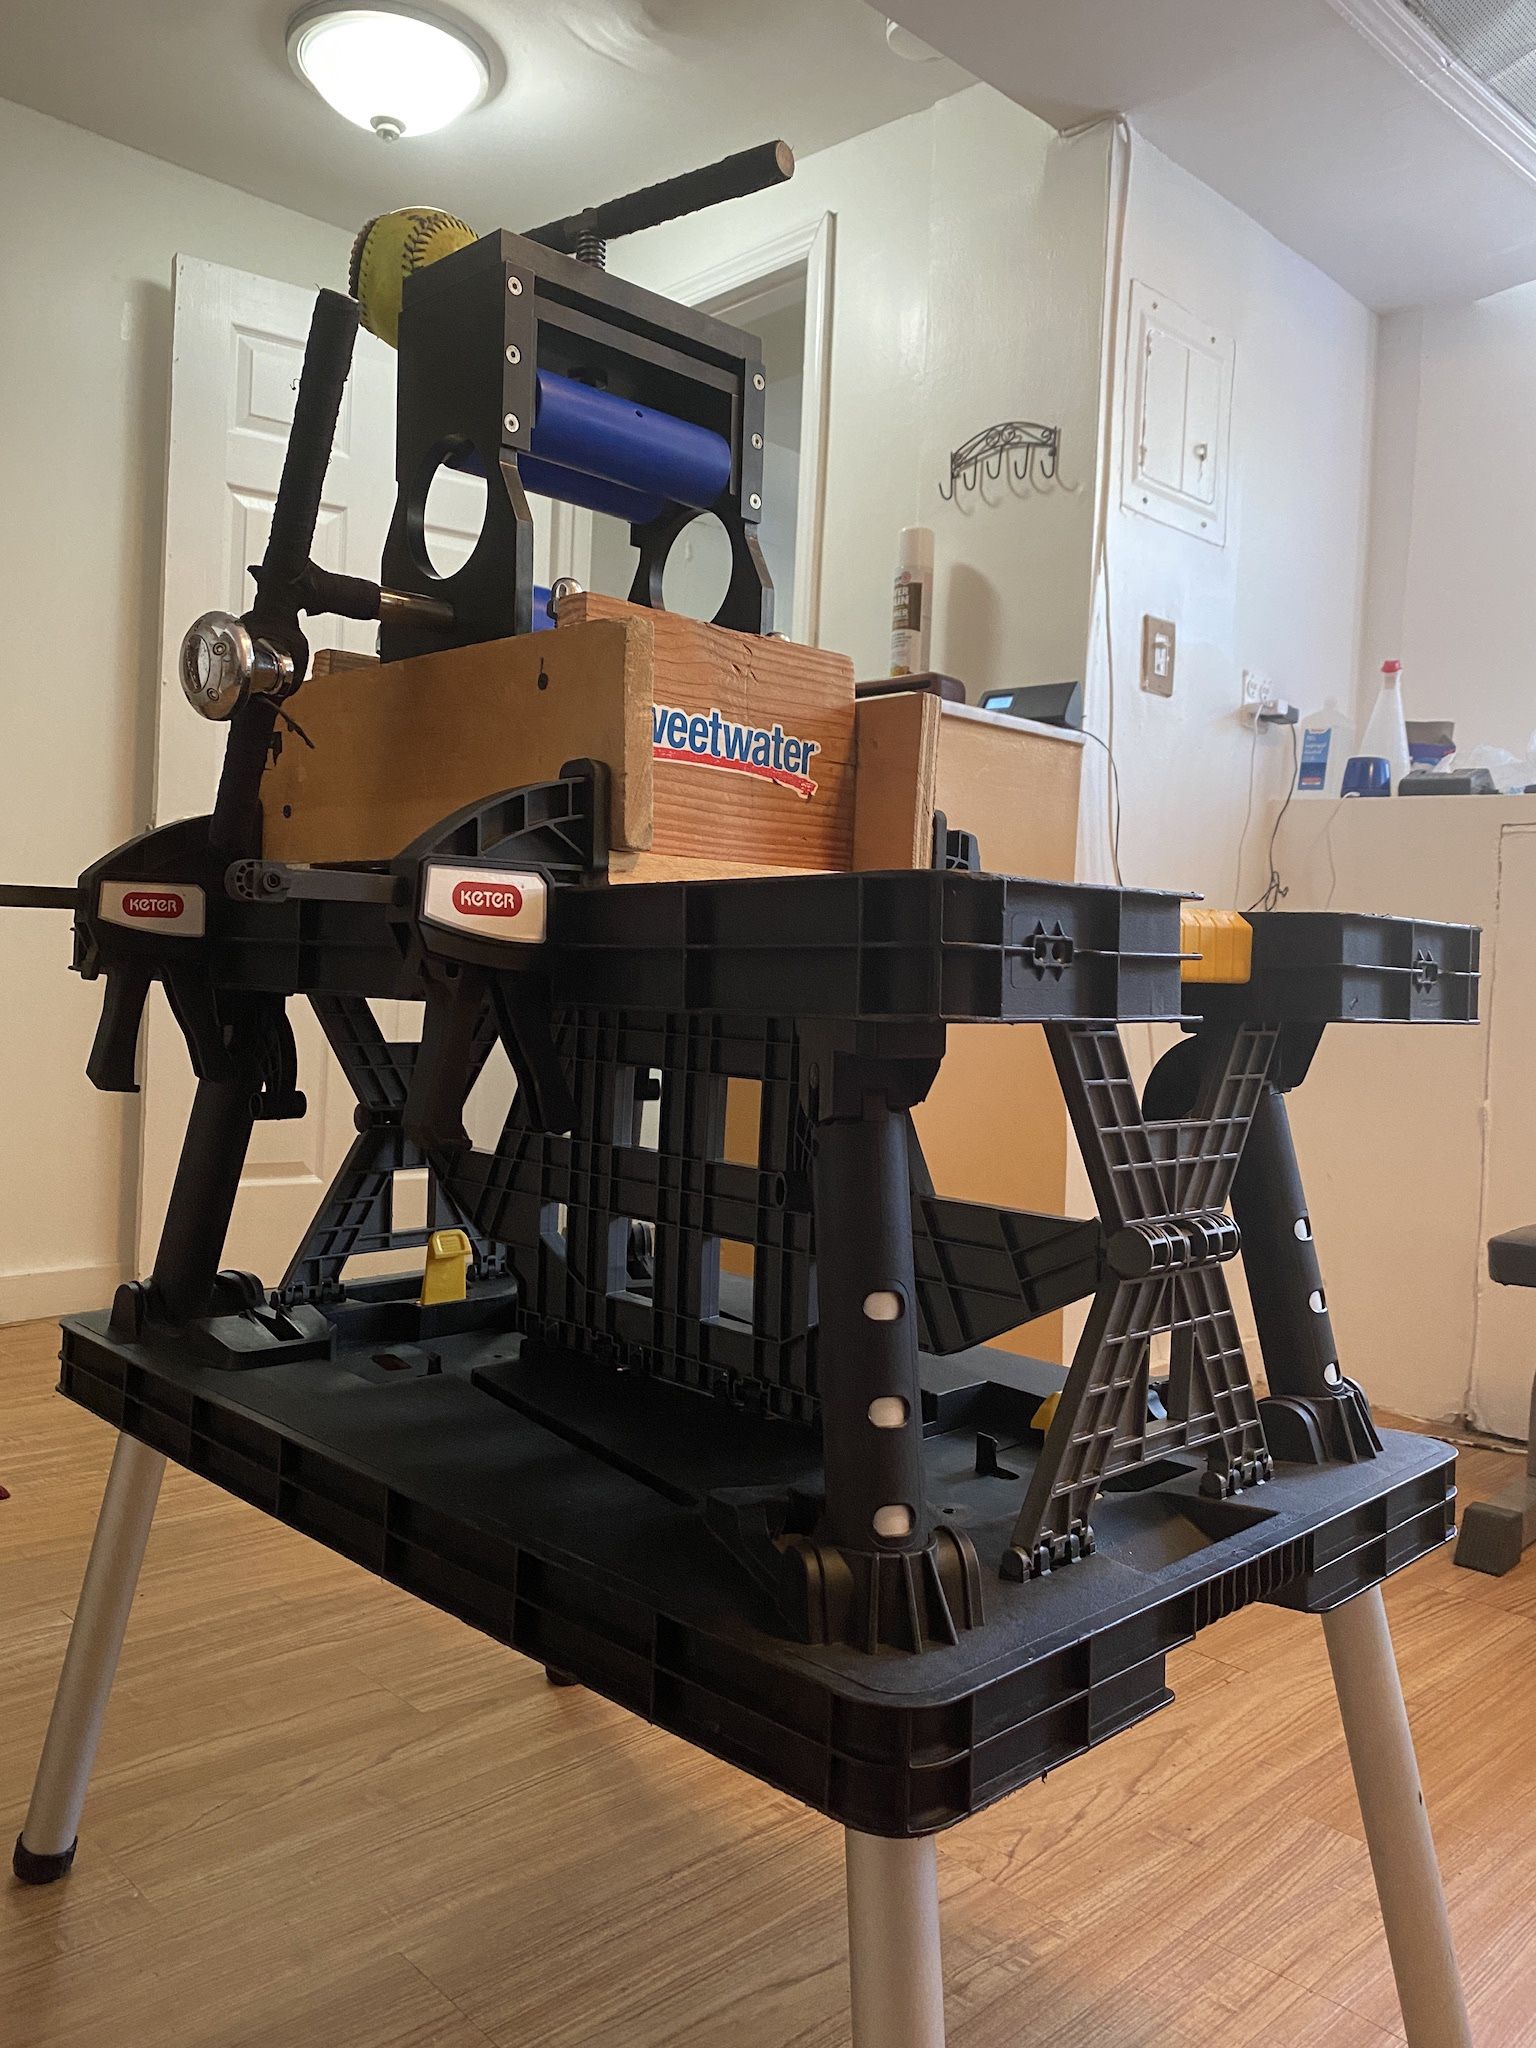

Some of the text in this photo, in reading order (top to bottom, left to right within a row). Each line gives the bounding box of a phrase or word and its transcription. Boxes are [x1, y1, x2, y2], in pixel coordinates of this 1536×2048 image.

[652, 706, 815, 775] eetwater
[129, 898, 177, 912] KETER
[461, 890, 515, 909] KETER
